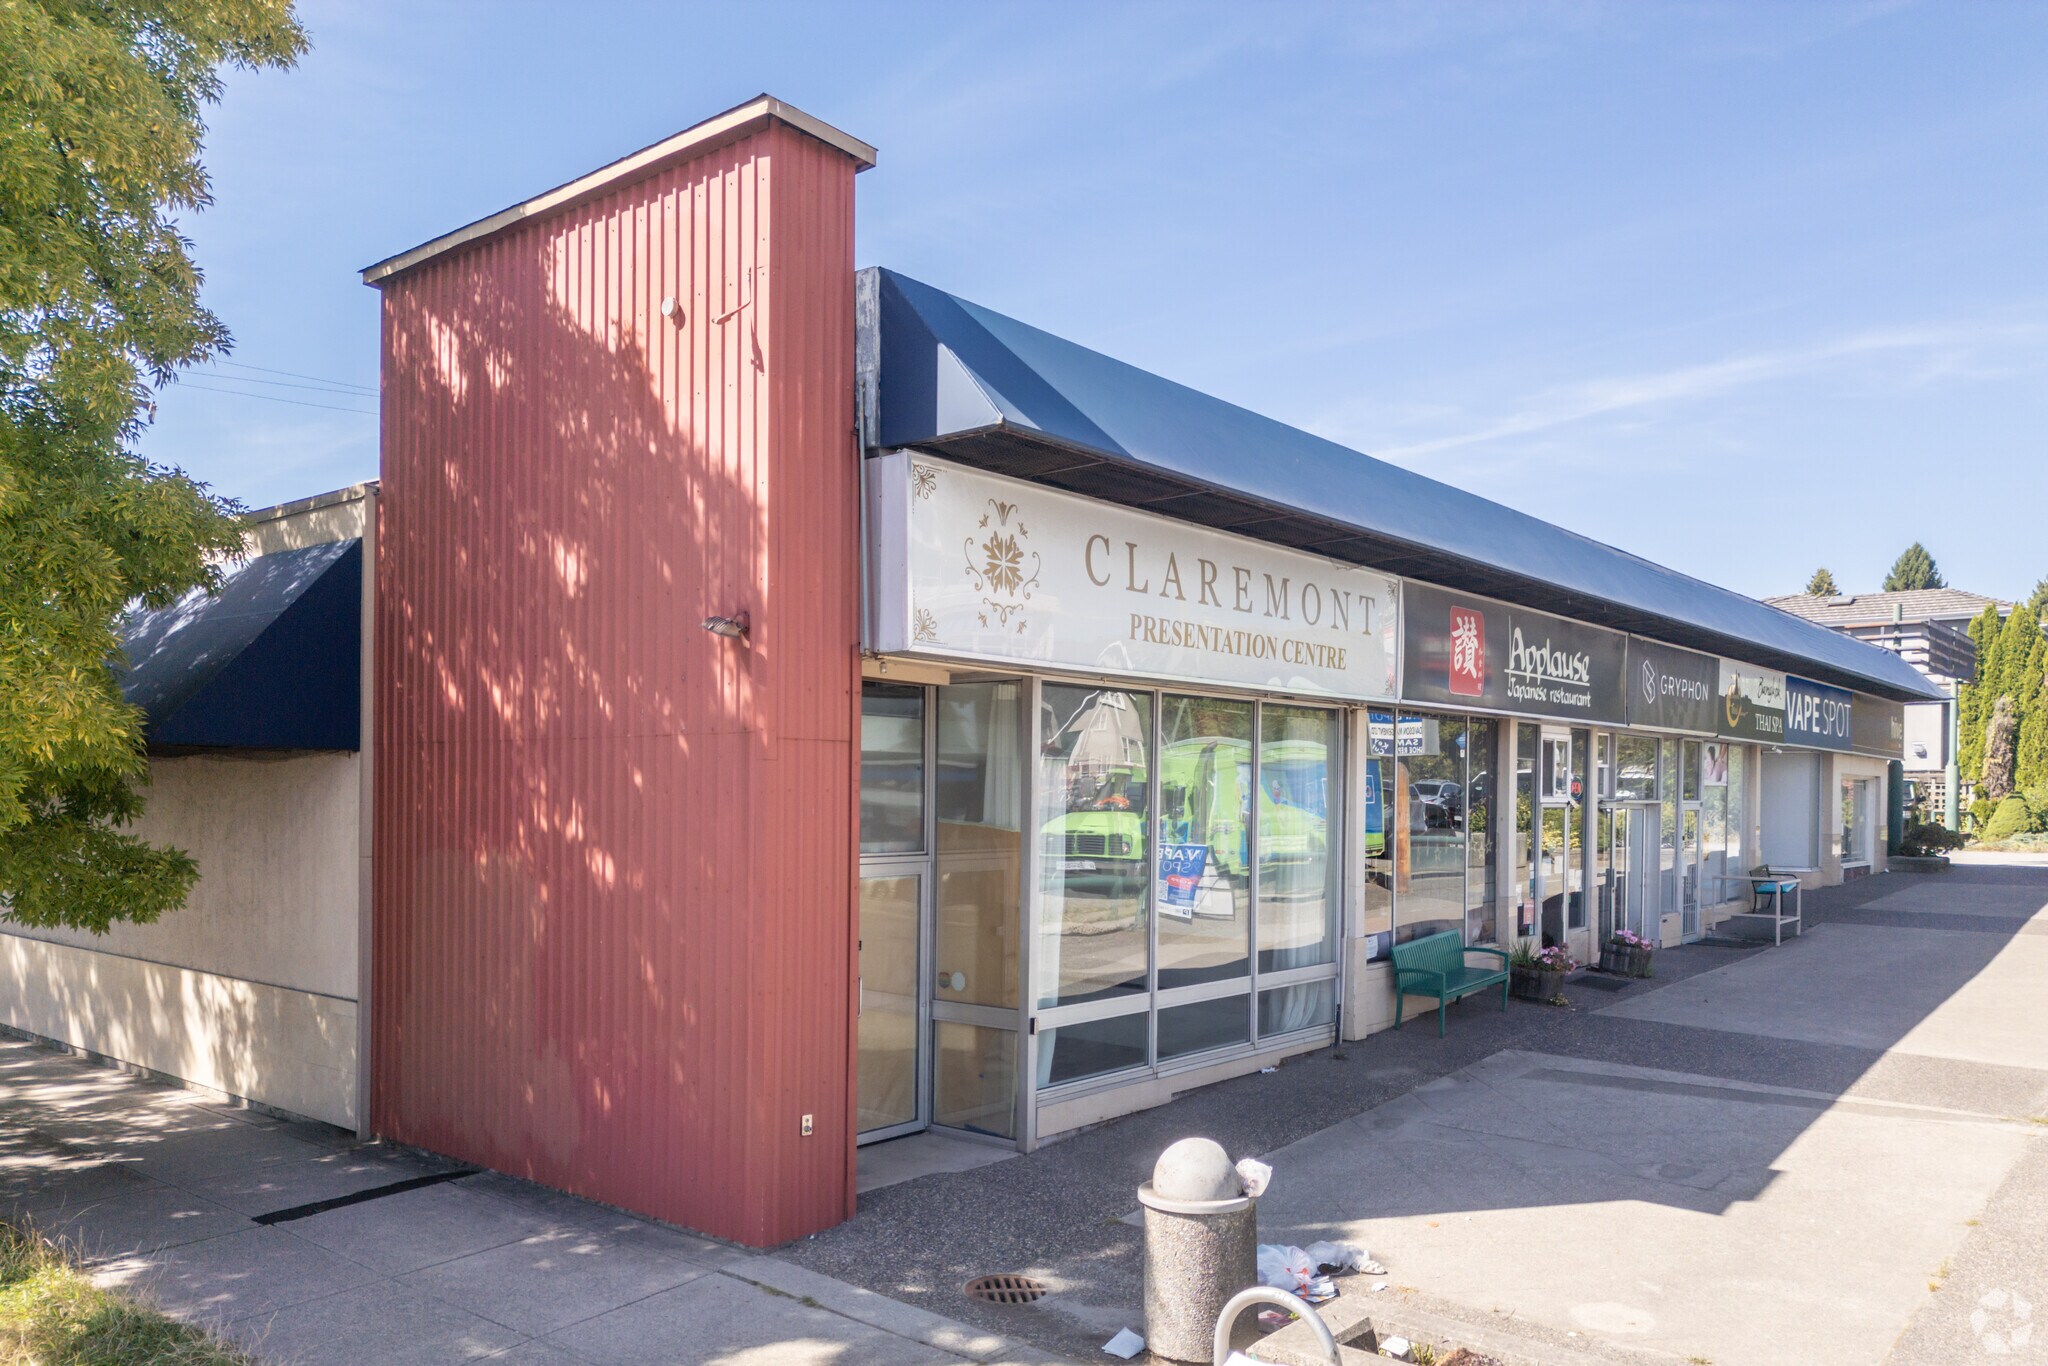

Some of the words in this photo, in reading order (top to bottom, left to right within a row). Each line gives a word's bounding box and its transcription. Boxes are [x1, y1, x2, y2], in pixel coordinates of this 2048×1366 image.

[1085, 533, 1376, 636] CLAREMONT
[1129, 612, 1278, 661] PRESENTATION
[1281, 639, 1347, 671] CENTRE
[1510, 626, 1590, 686] Applause
[1507, 677, 1547, 703] Japanese
[1549, 687, 1592, 708] restaurant
[1660, 674, 1709, 702] GRYPHON
[1755, 712, 1771, 733] THAI
[1771, 715, 1784, 734] SPA
[1786, 690, 1820, 734] VAPE
[1822, 698, 1852, 738] SPOT
